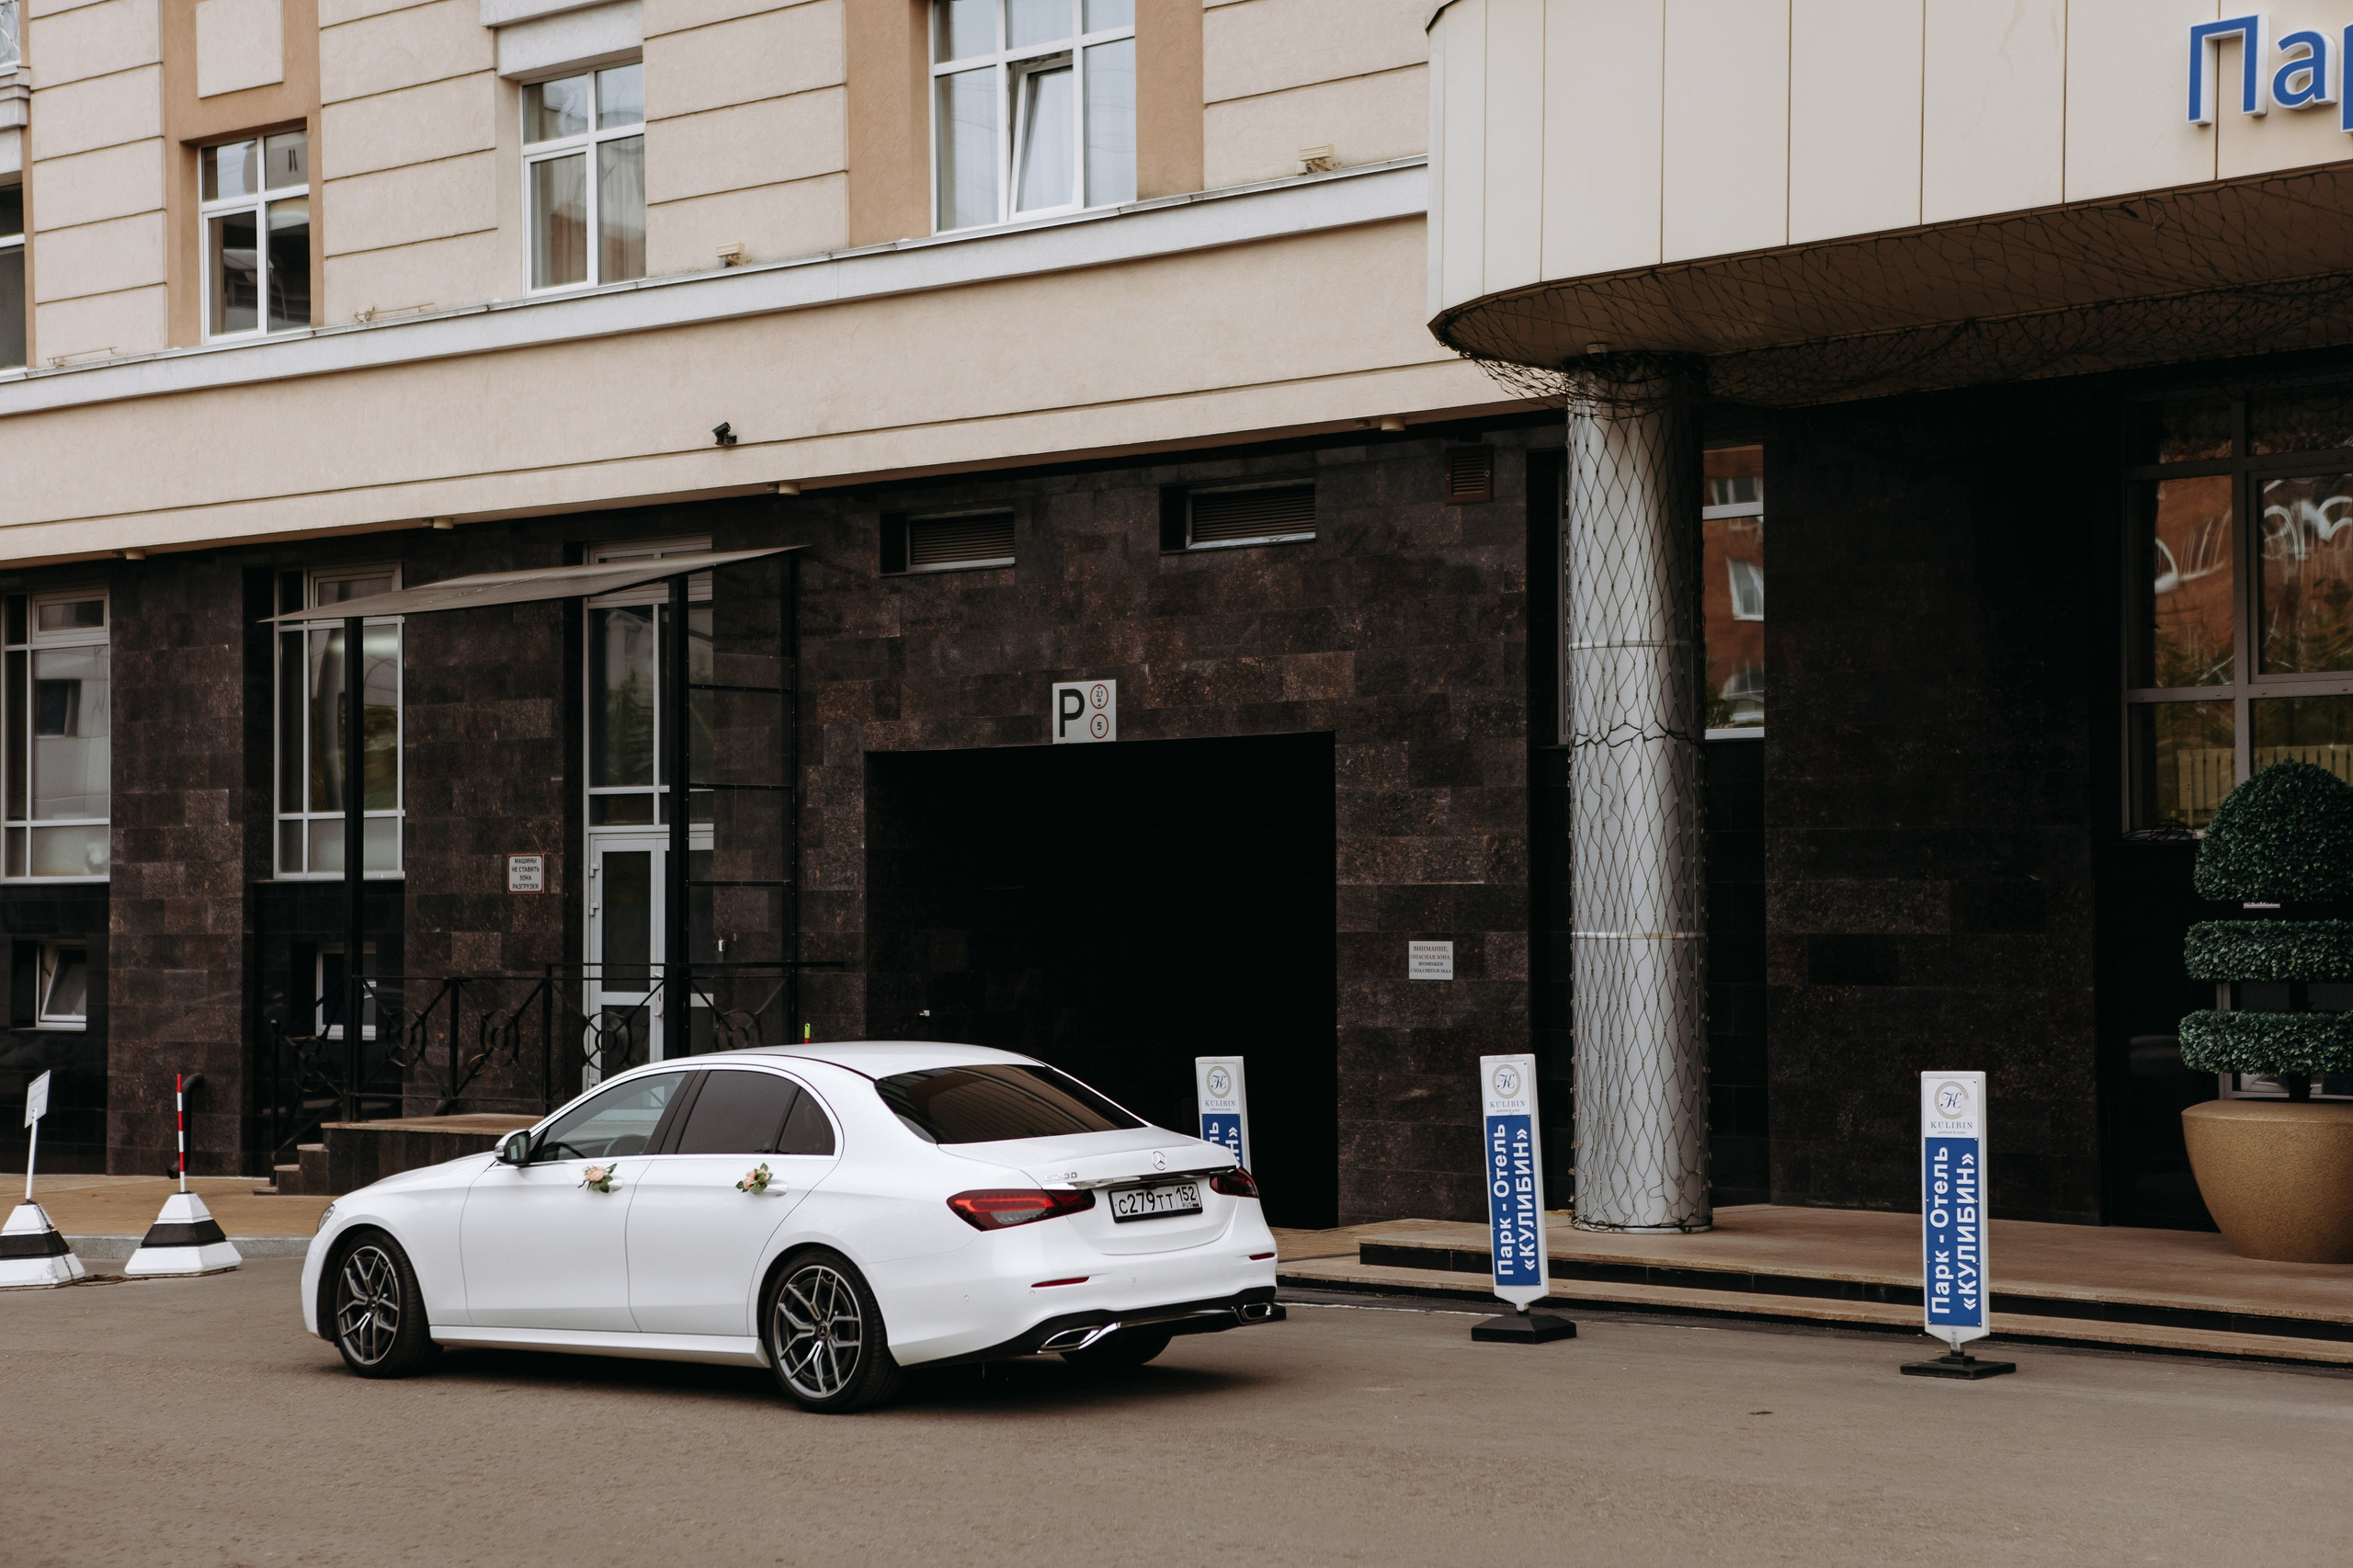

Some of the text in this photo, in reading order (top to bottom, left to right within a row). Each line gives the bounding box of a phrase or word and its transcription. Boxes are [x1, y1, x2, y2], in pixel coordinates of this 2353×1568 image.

[2188, 14, 2353, 132] Па
[1059, 688, 1085, 737] P
[1097, 722, 1102, 731] 5
[1489, 1100, 1526, 1108] KULIBIN
[1493, 1123, 1509, 1199] Отель
[1930, 1146, 1949, 1228] Отель
[1176, 1186, 1197, 1202] 152
[1512, 1128, 1536, 1271] «КУЛИБИН»
[1497, 1217, 1516, 1276] Парк
[1956, 1153, 1976, 1312] «КУЛИБИН»
[1931, 1250, 1954, 1314] Парк
